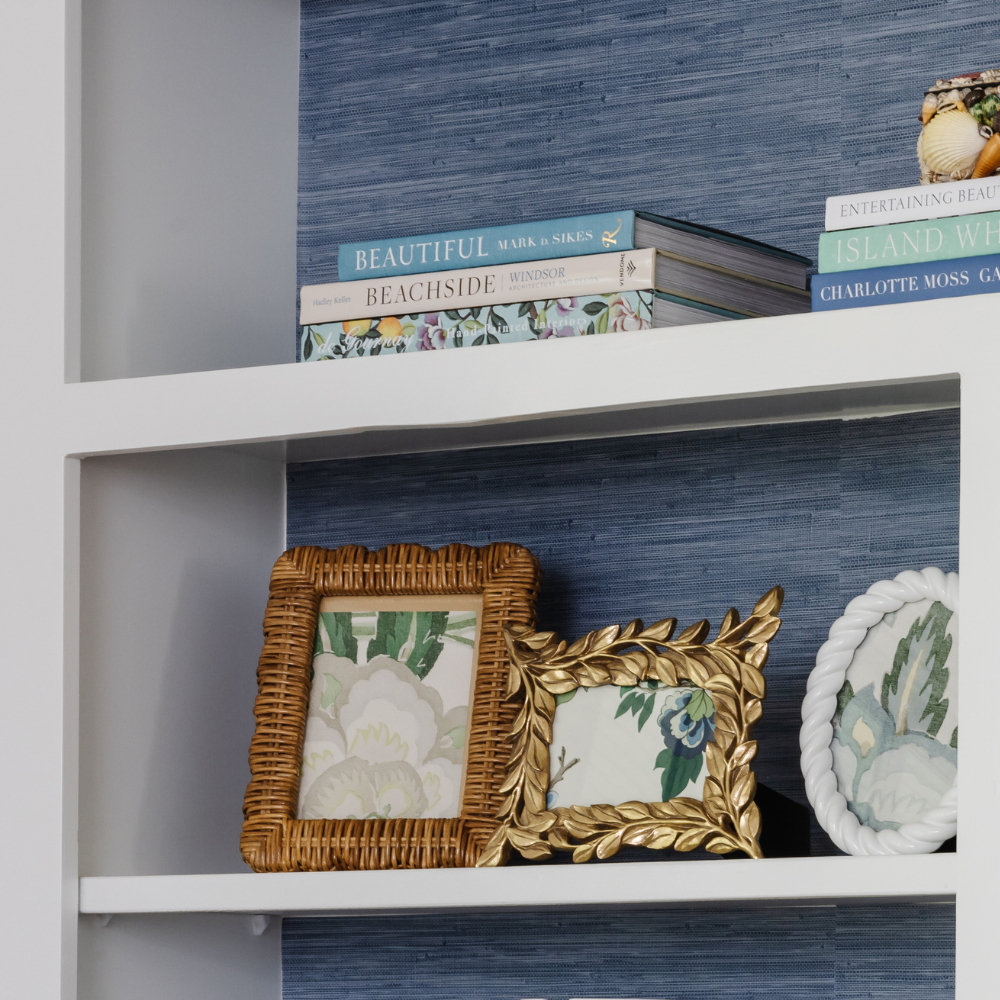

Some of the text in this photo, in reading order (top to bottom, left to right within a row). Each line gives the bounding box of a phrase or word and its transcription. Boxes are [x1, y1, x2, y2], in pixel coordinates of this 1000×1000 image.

[839, 191, 953, 218] ENTERTAINING
[355, 236, 489, 271] BEAUTIFUL
[497, 236, 537, 250] MARK
[552, 230, 594, 245] SIKES
[837, 227, 943, 264] ISLAND
[365, 274, 496, 307] BEACHSIDE
[508, 280, 556, 291] ARCHITECTURE
[559, 278, 572, 287] AND
[509, 267, 566, 283] WINDSOR
[820, 275, 919, 302] CHARLOTTE
[924, 270, 970, 290] MOSS
[312, 296, 351, 307] Hadley Keller
[317, 315, 588, 355] de Gournay Hand-Painted Interiors
